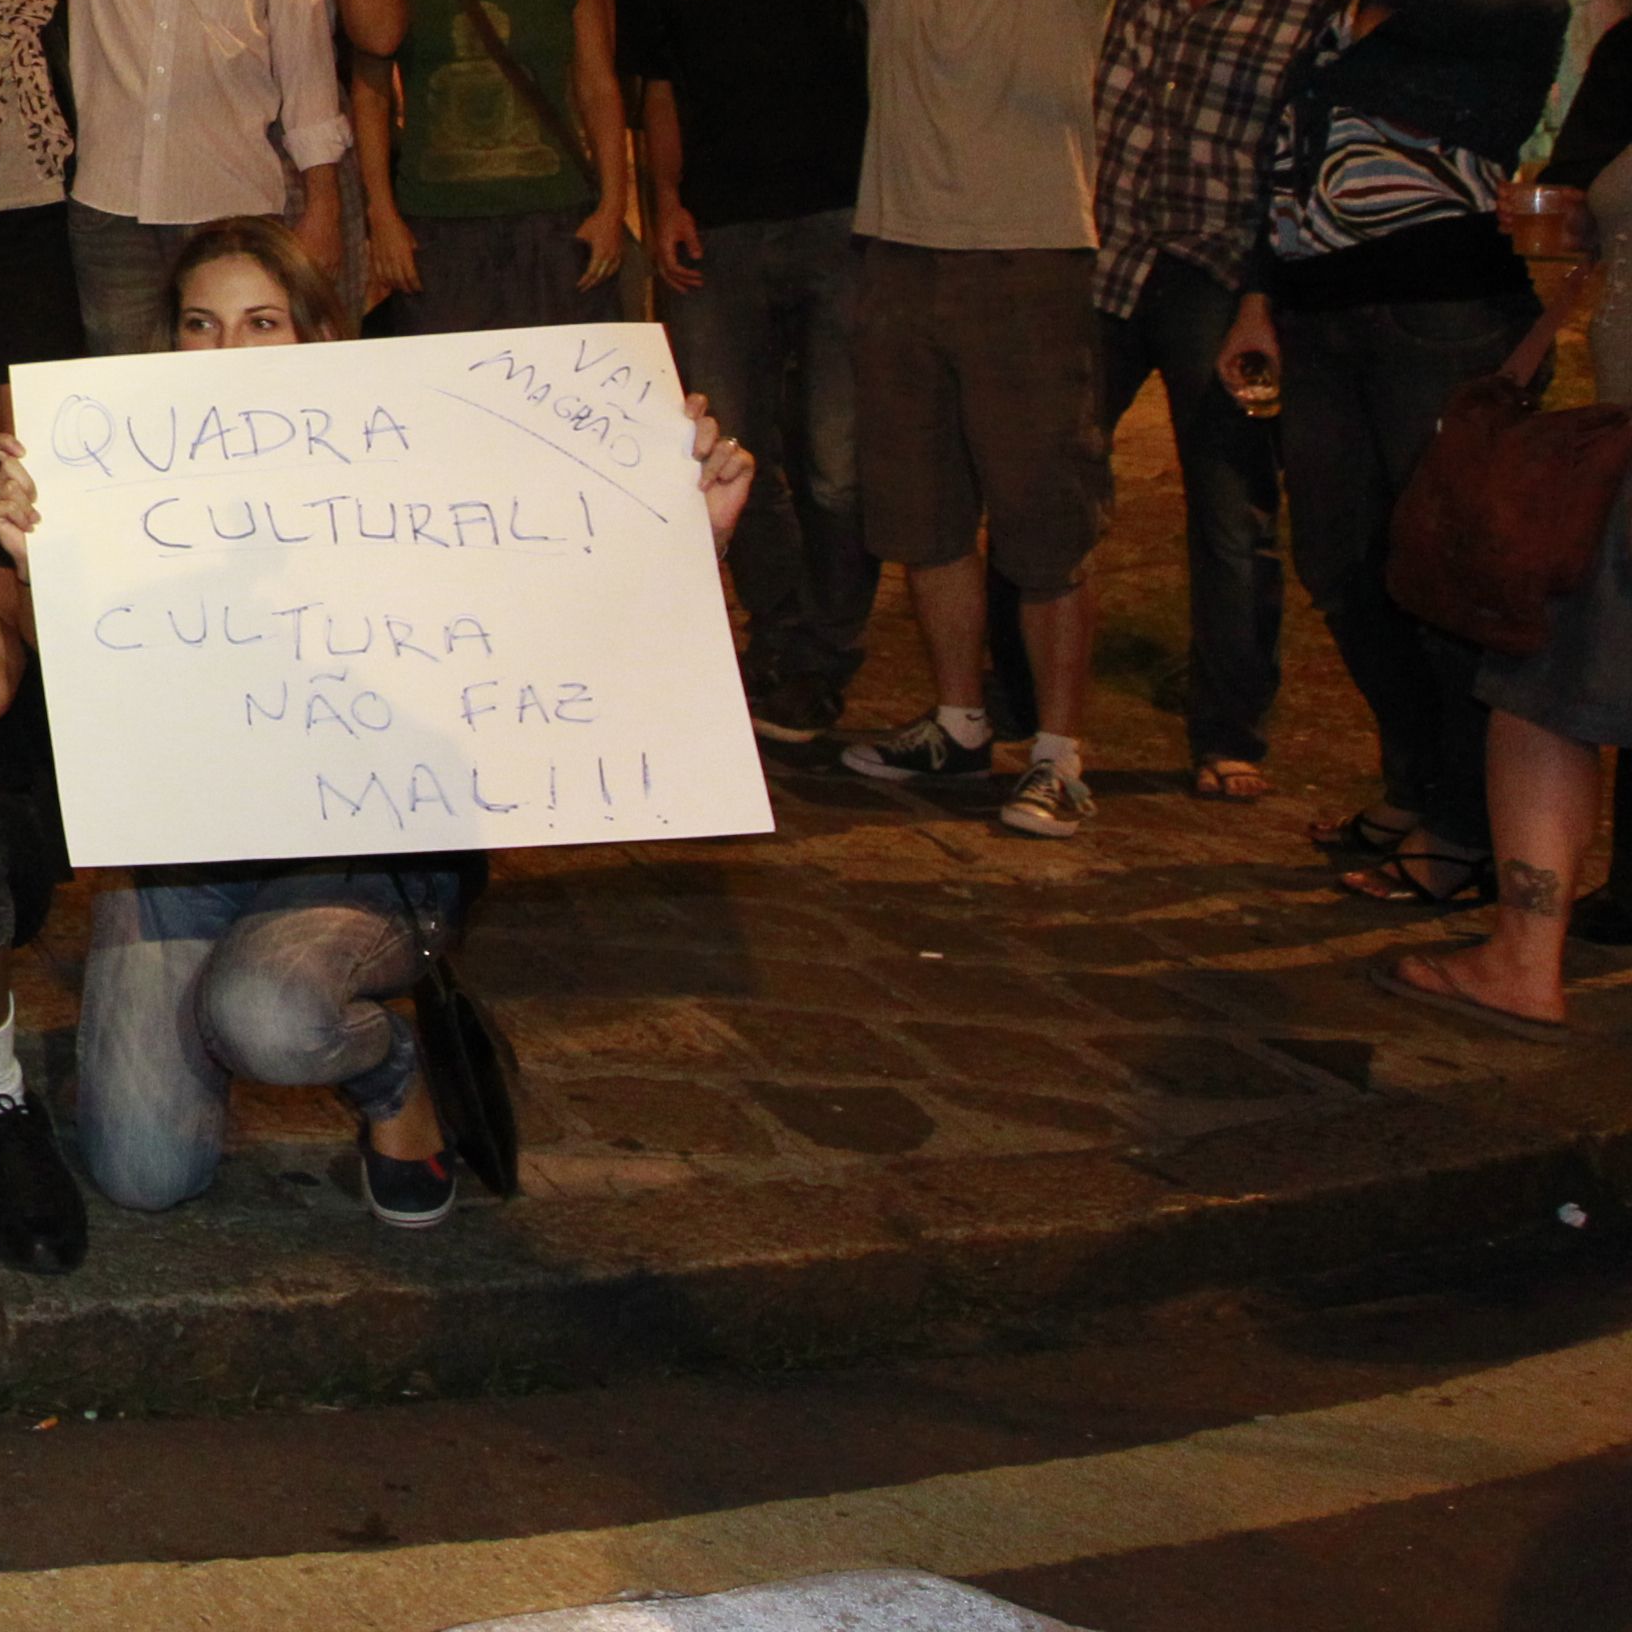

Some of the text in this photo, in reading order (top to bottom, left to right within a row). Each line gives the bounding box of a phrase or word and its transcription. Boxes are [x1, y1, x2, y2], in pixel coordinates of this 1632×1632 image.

[572, 339, 653, 404] VAI
[51, 394, 411, 478] QUADRA
[468, 349, 644, 470] MAGRÃO
[142, 491, 595, 556] CULTURAL!
[93, 603, 492, 665] CULTURA
[245, 673, 599, 738] NÃO FAZ
[317, 751, 670, 832] MAL!!!
